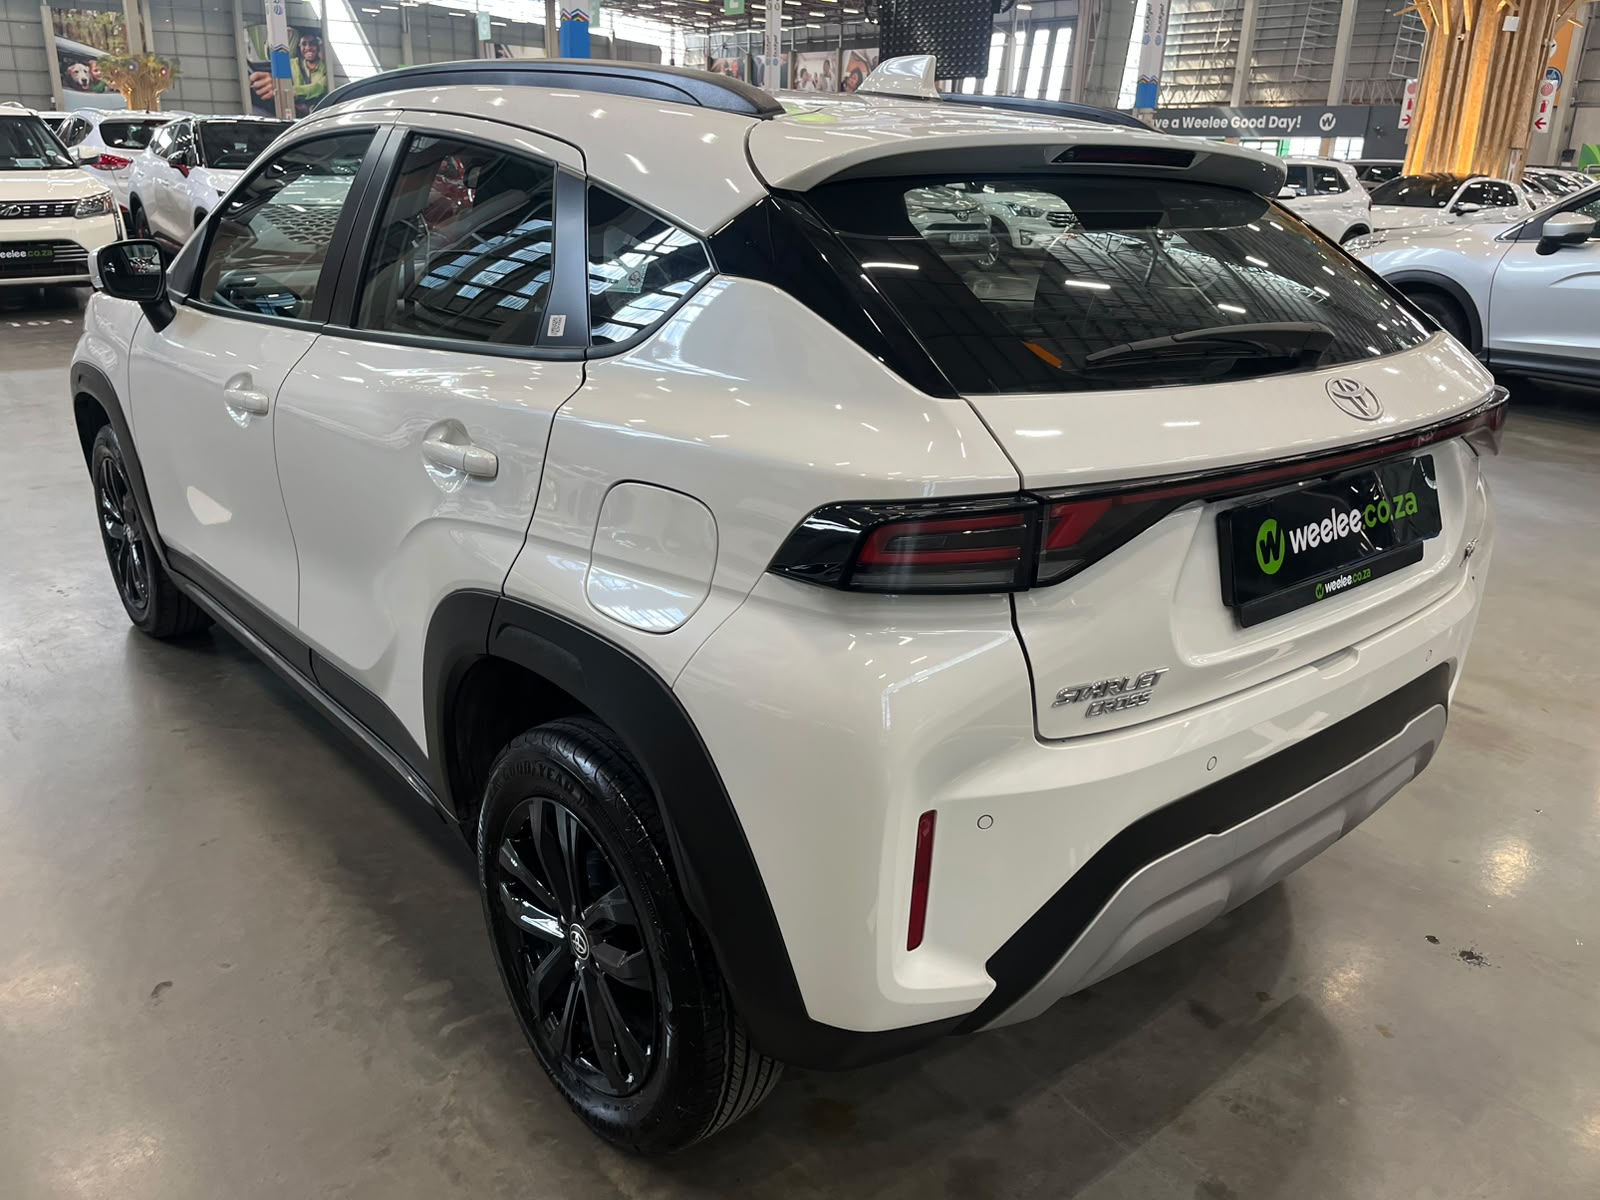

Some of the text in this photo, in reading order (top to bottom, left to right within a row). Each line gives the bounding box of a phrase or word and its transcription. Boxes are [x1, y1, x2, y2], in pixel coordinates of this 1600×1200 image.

[1152, 115, 1301, 132] ve a Weelee Good Day!
[1289, 492, 1418, 554] weelee.co.za
[1325, 568, 1371, 593] weelee.co.za
[1051, 667, 1170, 708] STARLET
[1085, 689, 1154, 718] CROSS
